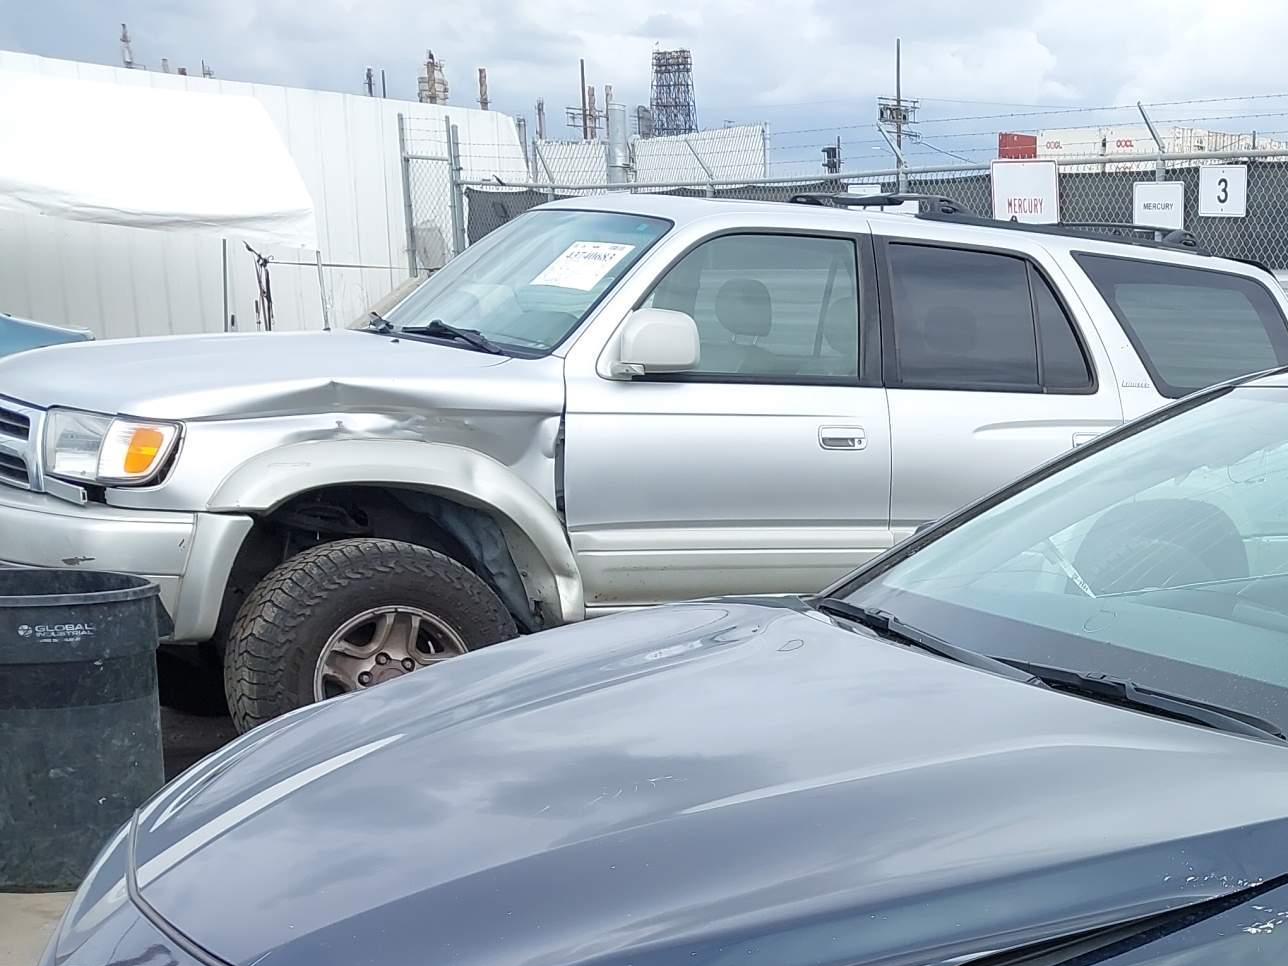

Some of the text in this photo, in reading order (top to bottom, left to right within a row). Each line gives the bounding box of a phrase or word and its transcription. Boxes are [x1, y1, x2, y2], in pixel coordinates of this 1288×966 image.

[1217, 178, 1229, 204] 3
[1007, 197, 1044, 214] MERCURY
[1143, 202, 1174, 211] MERCURY
[34, 623, 95, 632] GLOBAL
